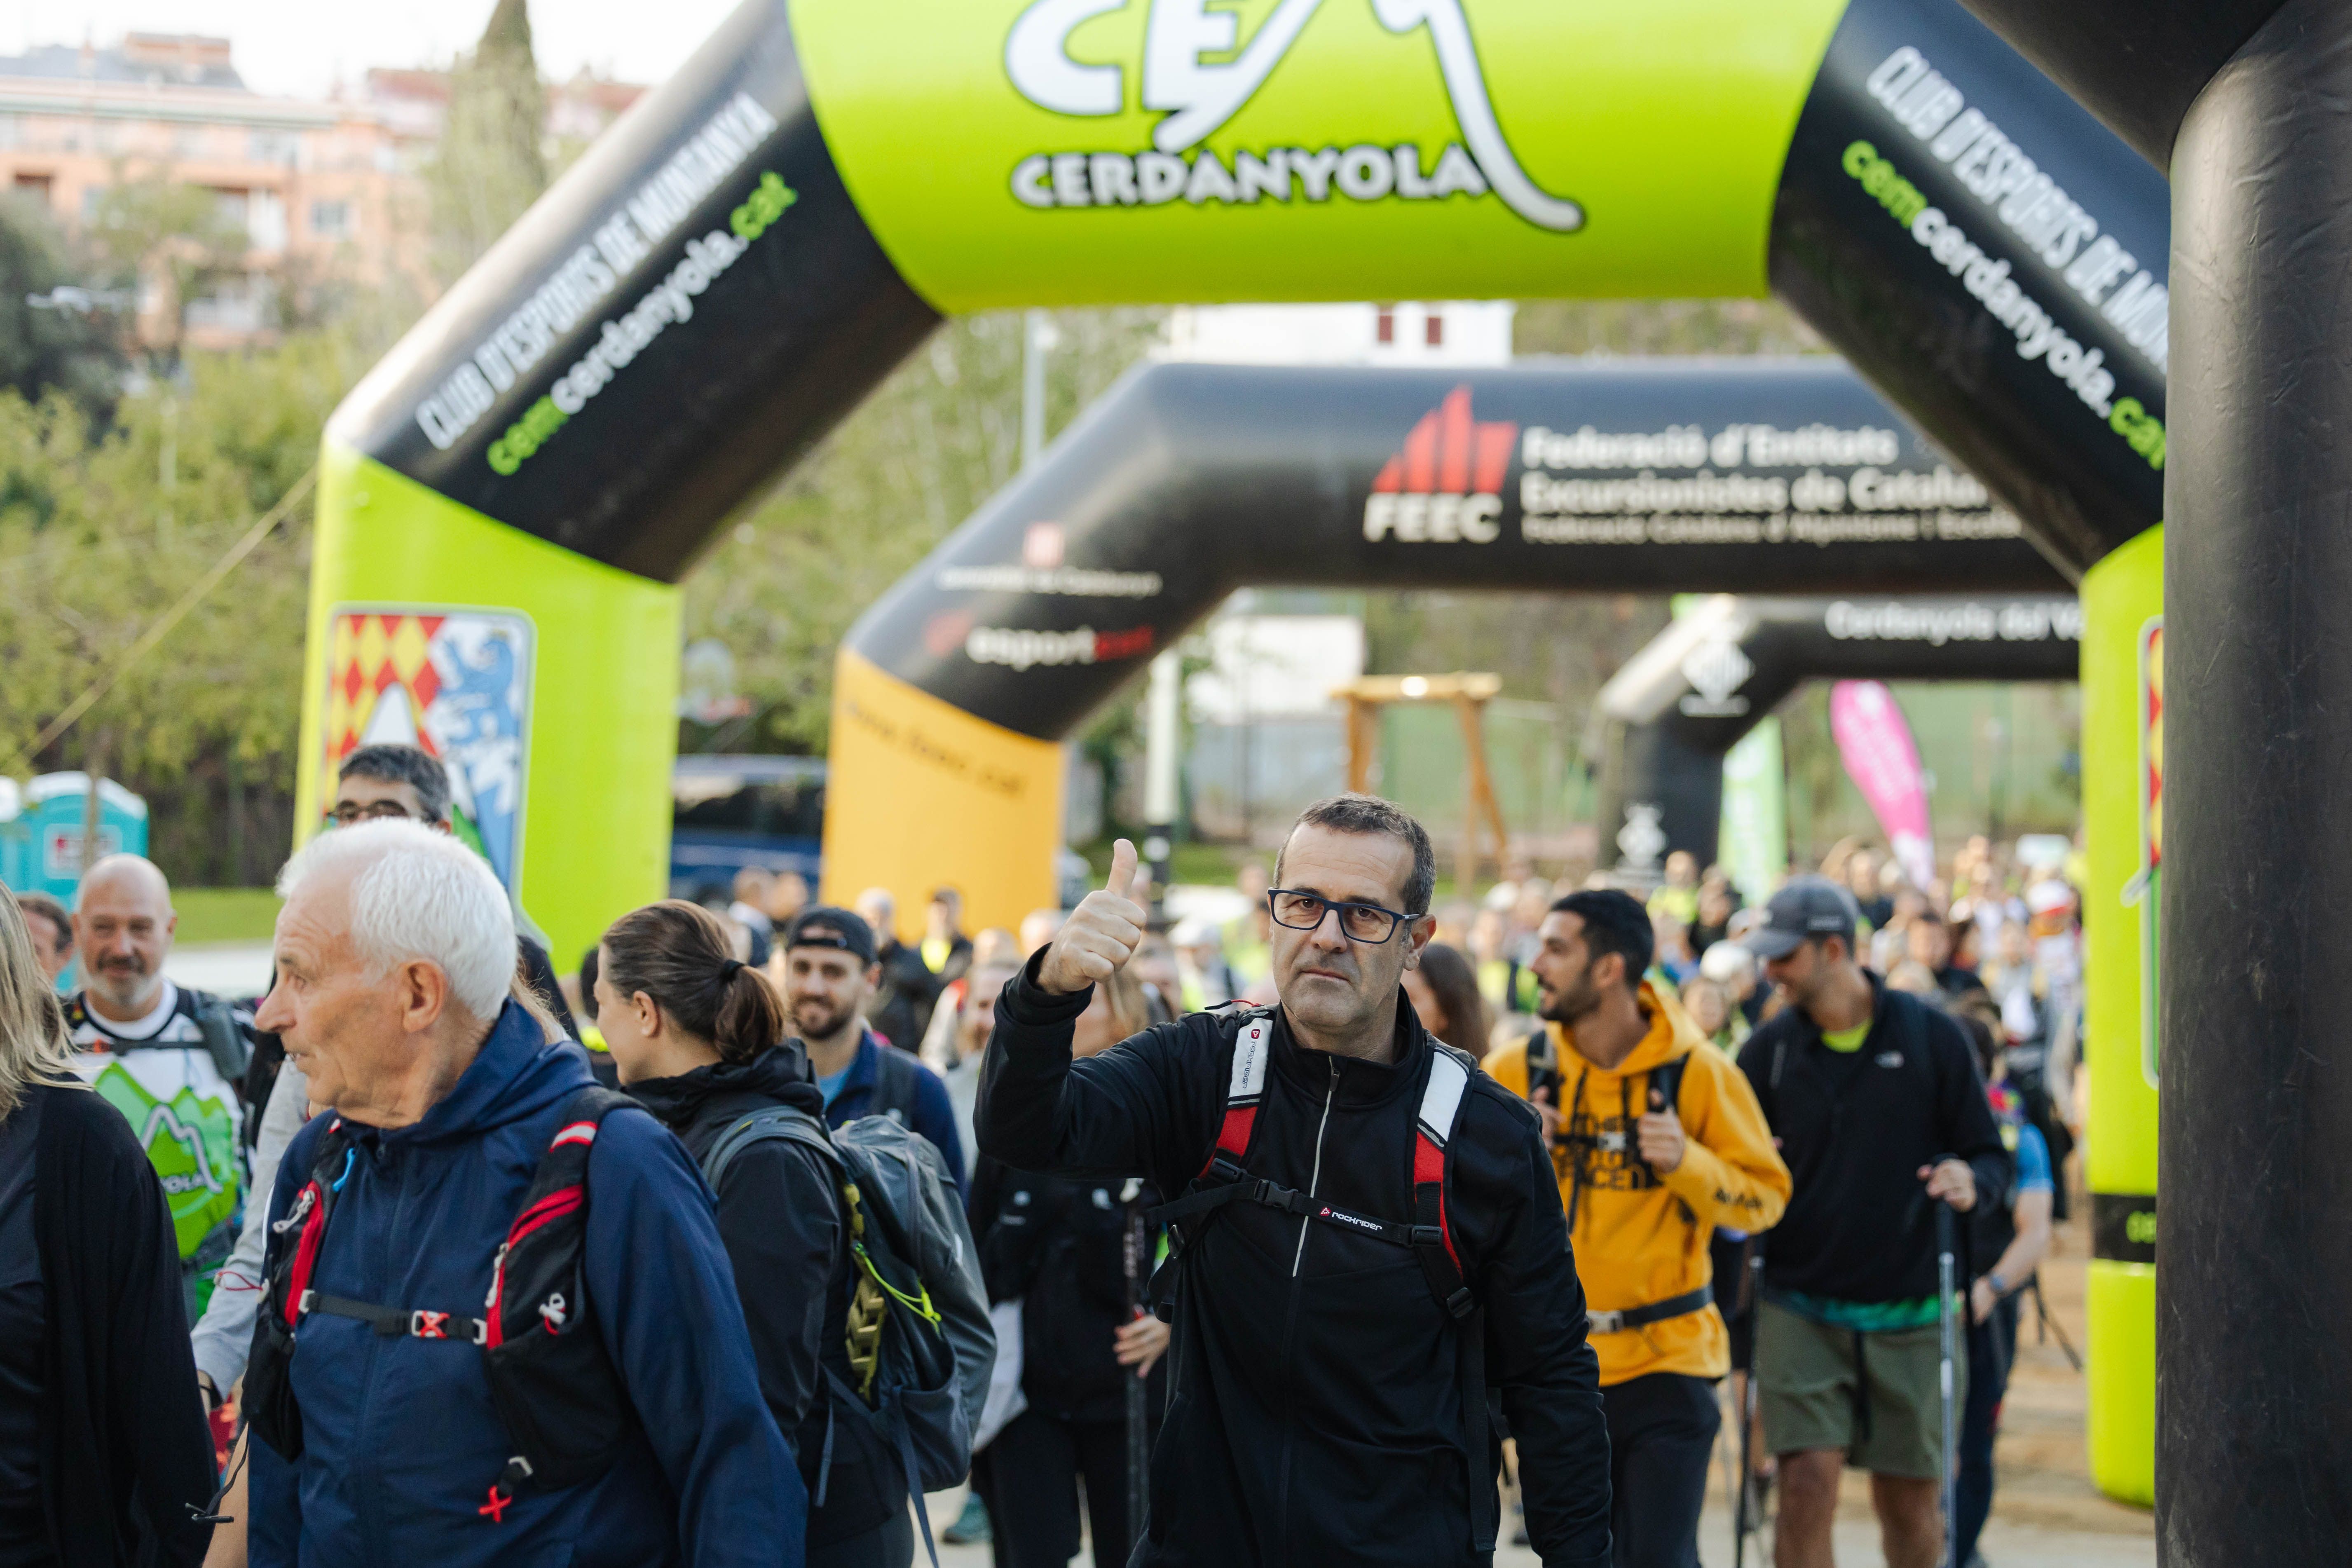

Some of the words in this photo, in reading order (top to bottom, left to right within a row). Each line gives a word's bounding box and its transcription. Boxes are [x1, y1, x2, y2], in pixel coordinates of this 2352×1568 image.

[1011, 143, 1489, 207] CERDANYOLA
[1867, 47, 1963, 141] CLUB
[2064, 235, 2137, 306] DE
[416, 362, 494, 449] CLUB
[593, 211, 651, 274] DE
[1523, 424, 1708, 469] Federació
[1521, 469, 1787, 514] Excursionistes
[1791, 468, 1846, 512] de
[1363, 493, 1503, 543] FEEC
[1825, 600, 1998, 646] Cerdanyola
[1998, 602, 2050, 640] del
